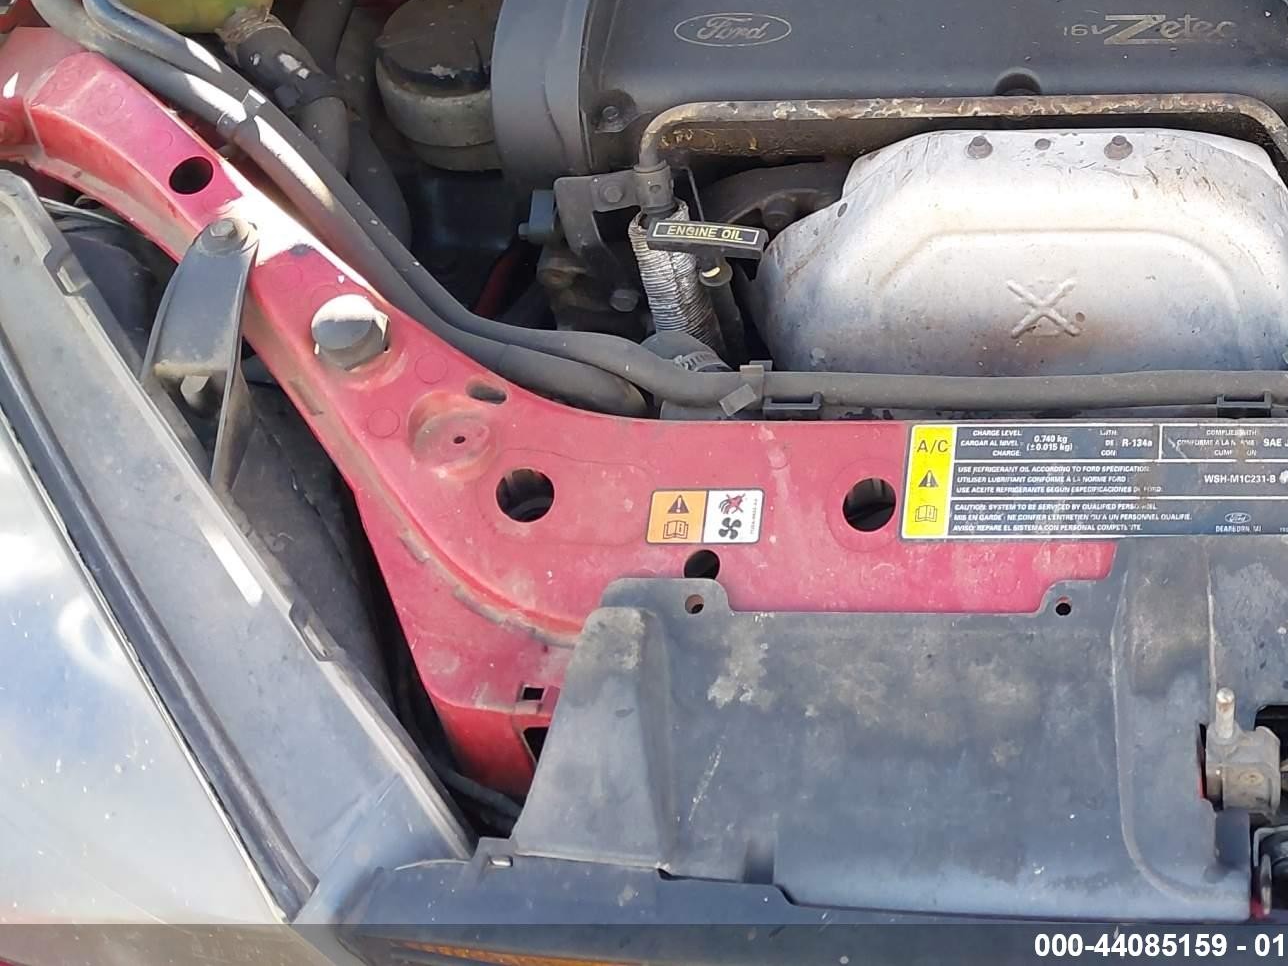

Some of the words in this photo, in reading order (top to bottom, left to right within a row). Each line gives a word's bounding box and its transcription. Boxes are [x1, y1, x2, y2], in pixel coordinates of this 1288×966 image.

[697, 16, 770, 40] Ford
[1064, 24, 1118, 36] 16V
[1104, 14, 1237, 45] Zetec
[667, 225, 719, 238] ENGINE
[721, 229, 744, 241] OIL
[1033, 434, 1056, 443] 0.740
[1057, 434, 1068, 444] kg
[1121, 438, 1153, 448] R-134a
[1263, 438, 1282, 447] SAE
[917, 439, 949, 454] A/C
[1059, 443, 1073, 453] kg)
[1203, 475, 1277, 483] WSH-M1C231-B
